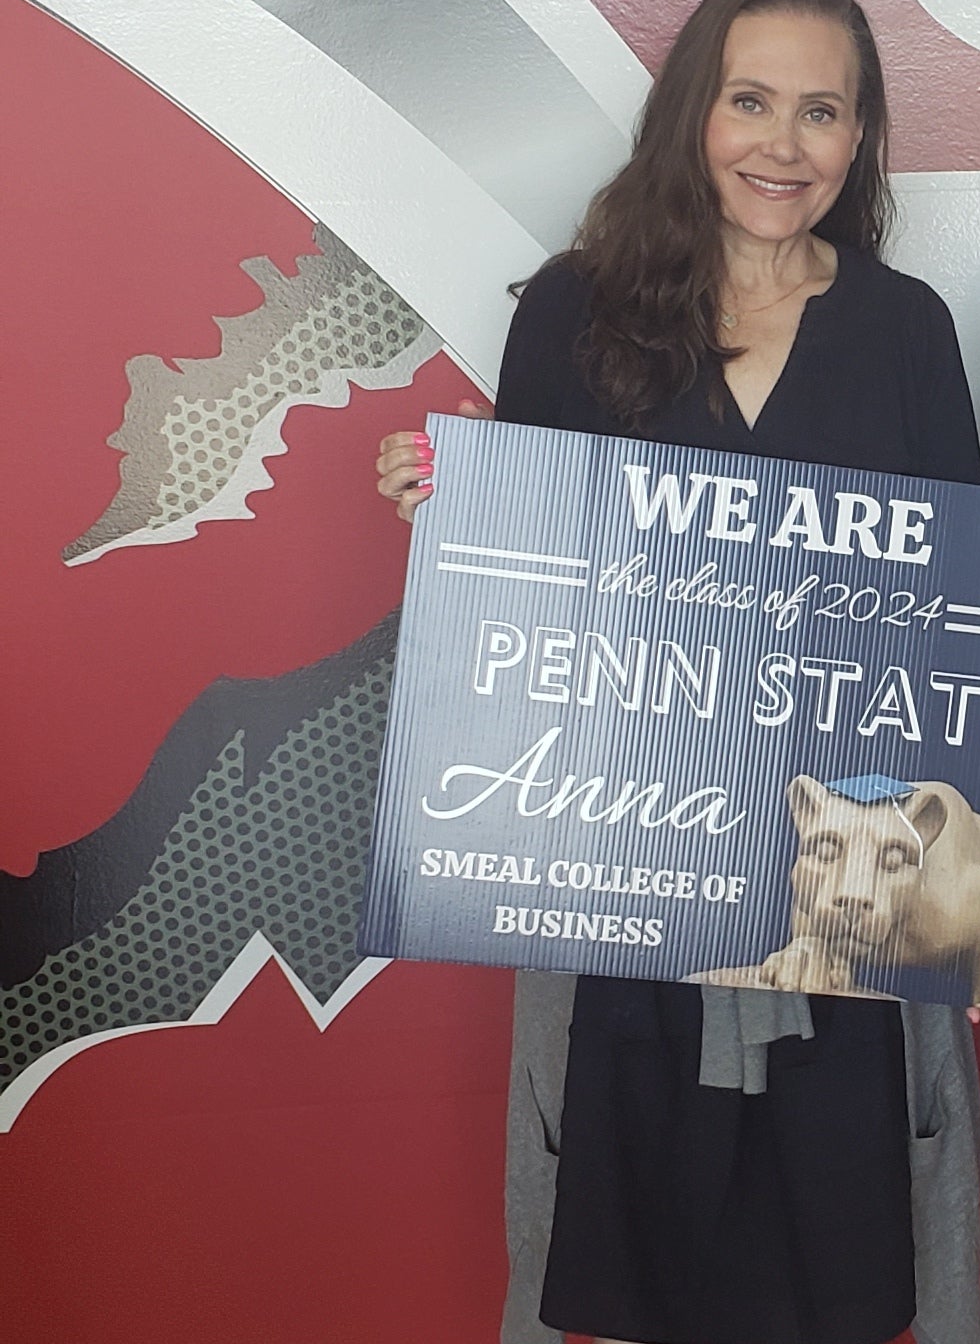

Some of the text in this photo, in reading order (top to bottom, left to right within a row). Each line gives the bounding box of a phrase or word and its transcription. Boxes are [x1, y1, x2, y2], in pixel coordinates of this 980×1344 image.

[623, 464, 934, 567] WE ARE
[597, 554, 945, 632] the class of 2024
[474, 620, 721, 719] PENN
[422, 726, 747, 834] Anna
[420, 848, 747, 904] SMEAL COLLEGE OF
[492, 905, 664, 946] BUSINESS
